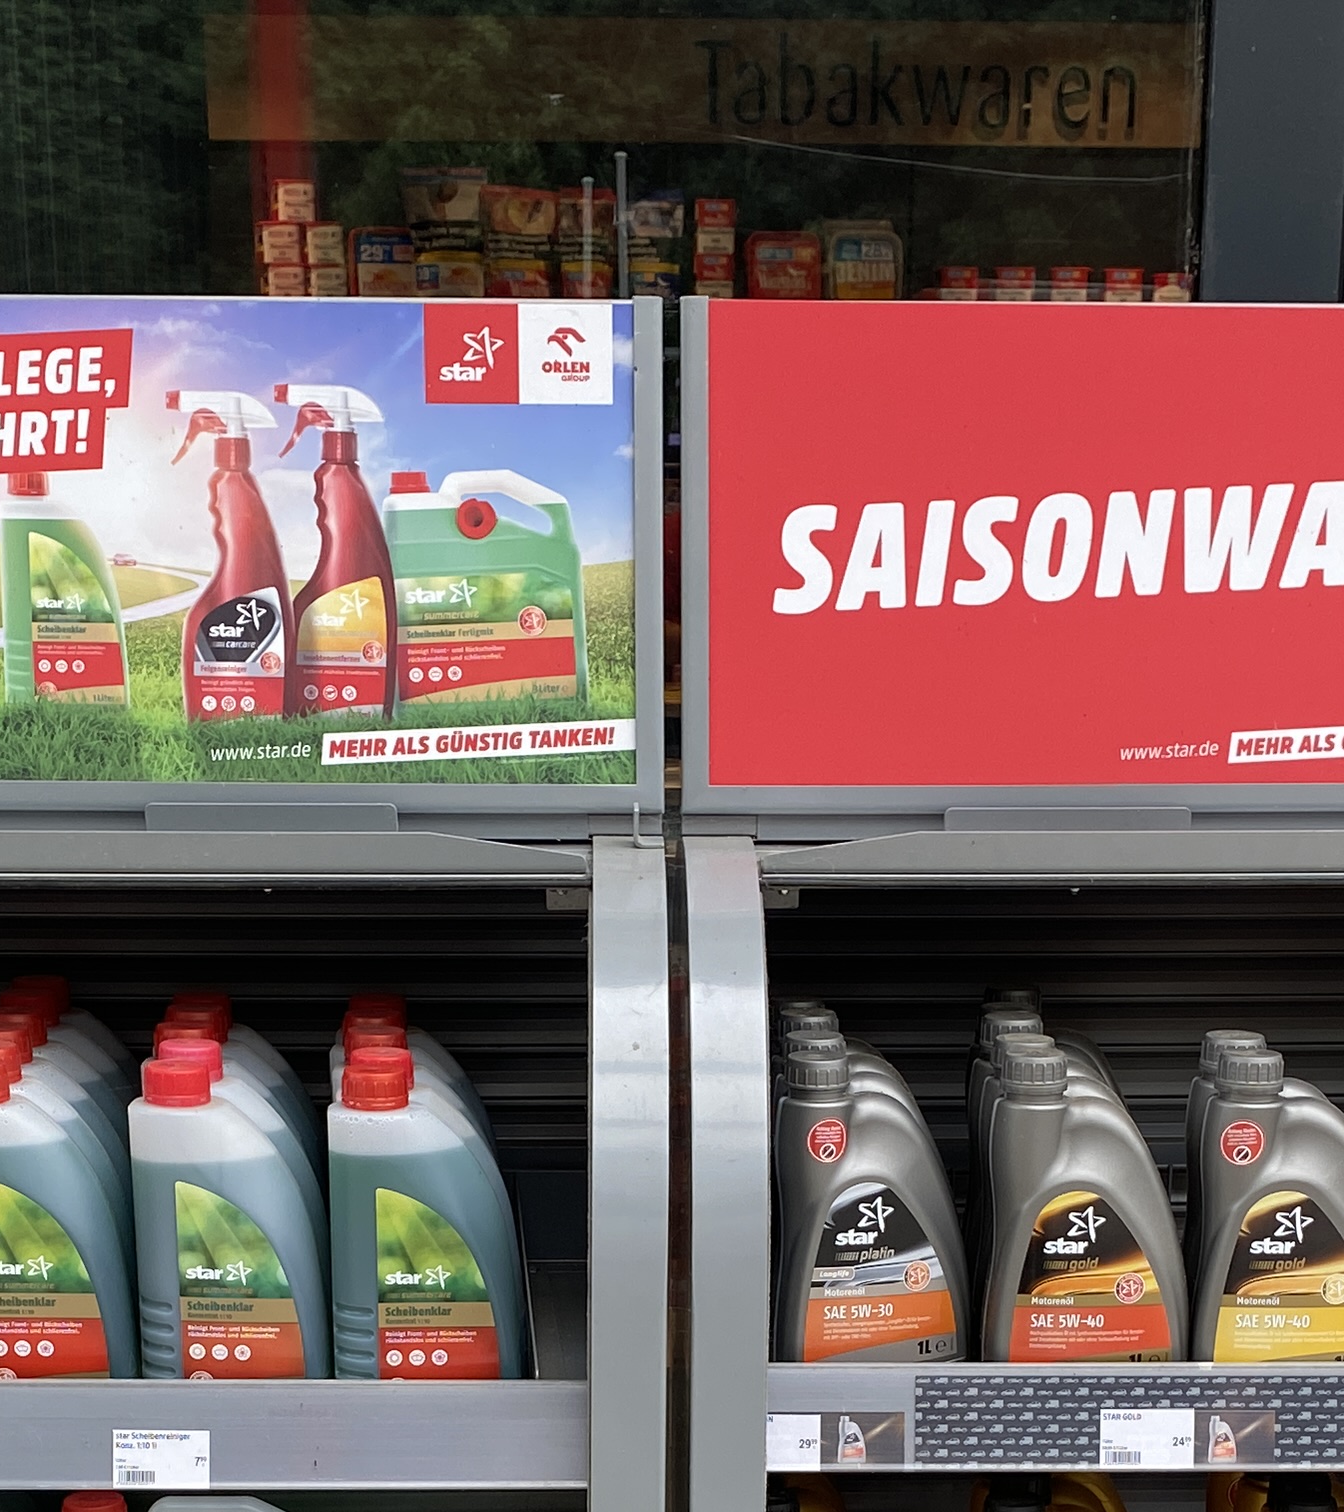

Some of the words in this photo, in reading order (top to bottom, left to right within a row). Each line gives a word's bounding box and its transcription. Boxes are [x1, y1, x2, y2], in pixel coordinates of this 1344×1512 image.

[696, 33, 1137, 136] Tabakwaren
[439, 364, 488, 384] star
[541, 359, 591, 375] ORLEN
[404, 586, 446, 604] star
[208, 622, 245, 638] star
[328, 738, 386, 759] MEHR
[390, 736, 430, 756] ALS
[433, 730, 523, 753] GÜNSTIG
[527, 726, 614, 748] TANKEN!
[1118, 739, 1220, 762] www.star.de
[1235, 734, 1294, 759] MEHR
[1298, 732, 1338, 754] ALS
[210, 742, 311, 762] www.star.de
[835, 1228, 879, 1246] star
[1042, 1236, 1089, 1255] star
[1248, 1236, 1295, 1255] star
[859, 1246, 895, 1264] platin
[1069, 1255, 1099, 1272] gold
[1275, 1255, 1306, 1272] gold
[185, 1265, 224, 1280] star
[384, 1271, 423, 1285] star
[823, 1304, 847, 1319] SAE
[849, 1302, 894, 1318] 5W-30
[1030, 1313, 1054, 1328] SAE
[1058, 1313, 1105, 1328] 5W-40
[1234, 1313, 1259, 1328] SAE
[1262, 1313, 1310, 1328] 5W-40
[917, 1339, 933, 1356] 1L
